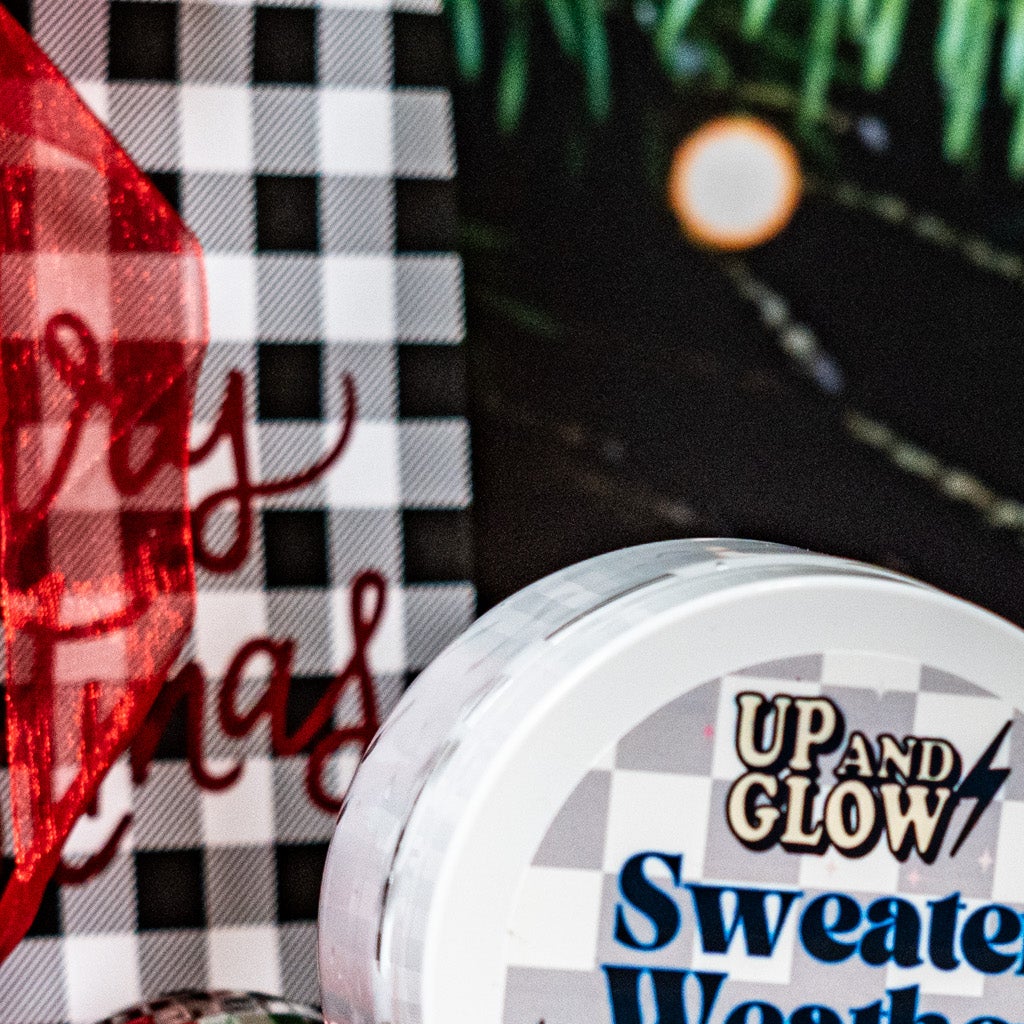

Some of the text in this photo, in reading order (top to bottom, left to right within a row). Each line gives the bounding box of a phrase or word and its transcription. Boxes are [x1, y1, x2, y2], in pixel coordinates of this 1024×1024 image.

[735, 691, 962, 785] UP AND
[726, 771, 961, 865] GLOW
